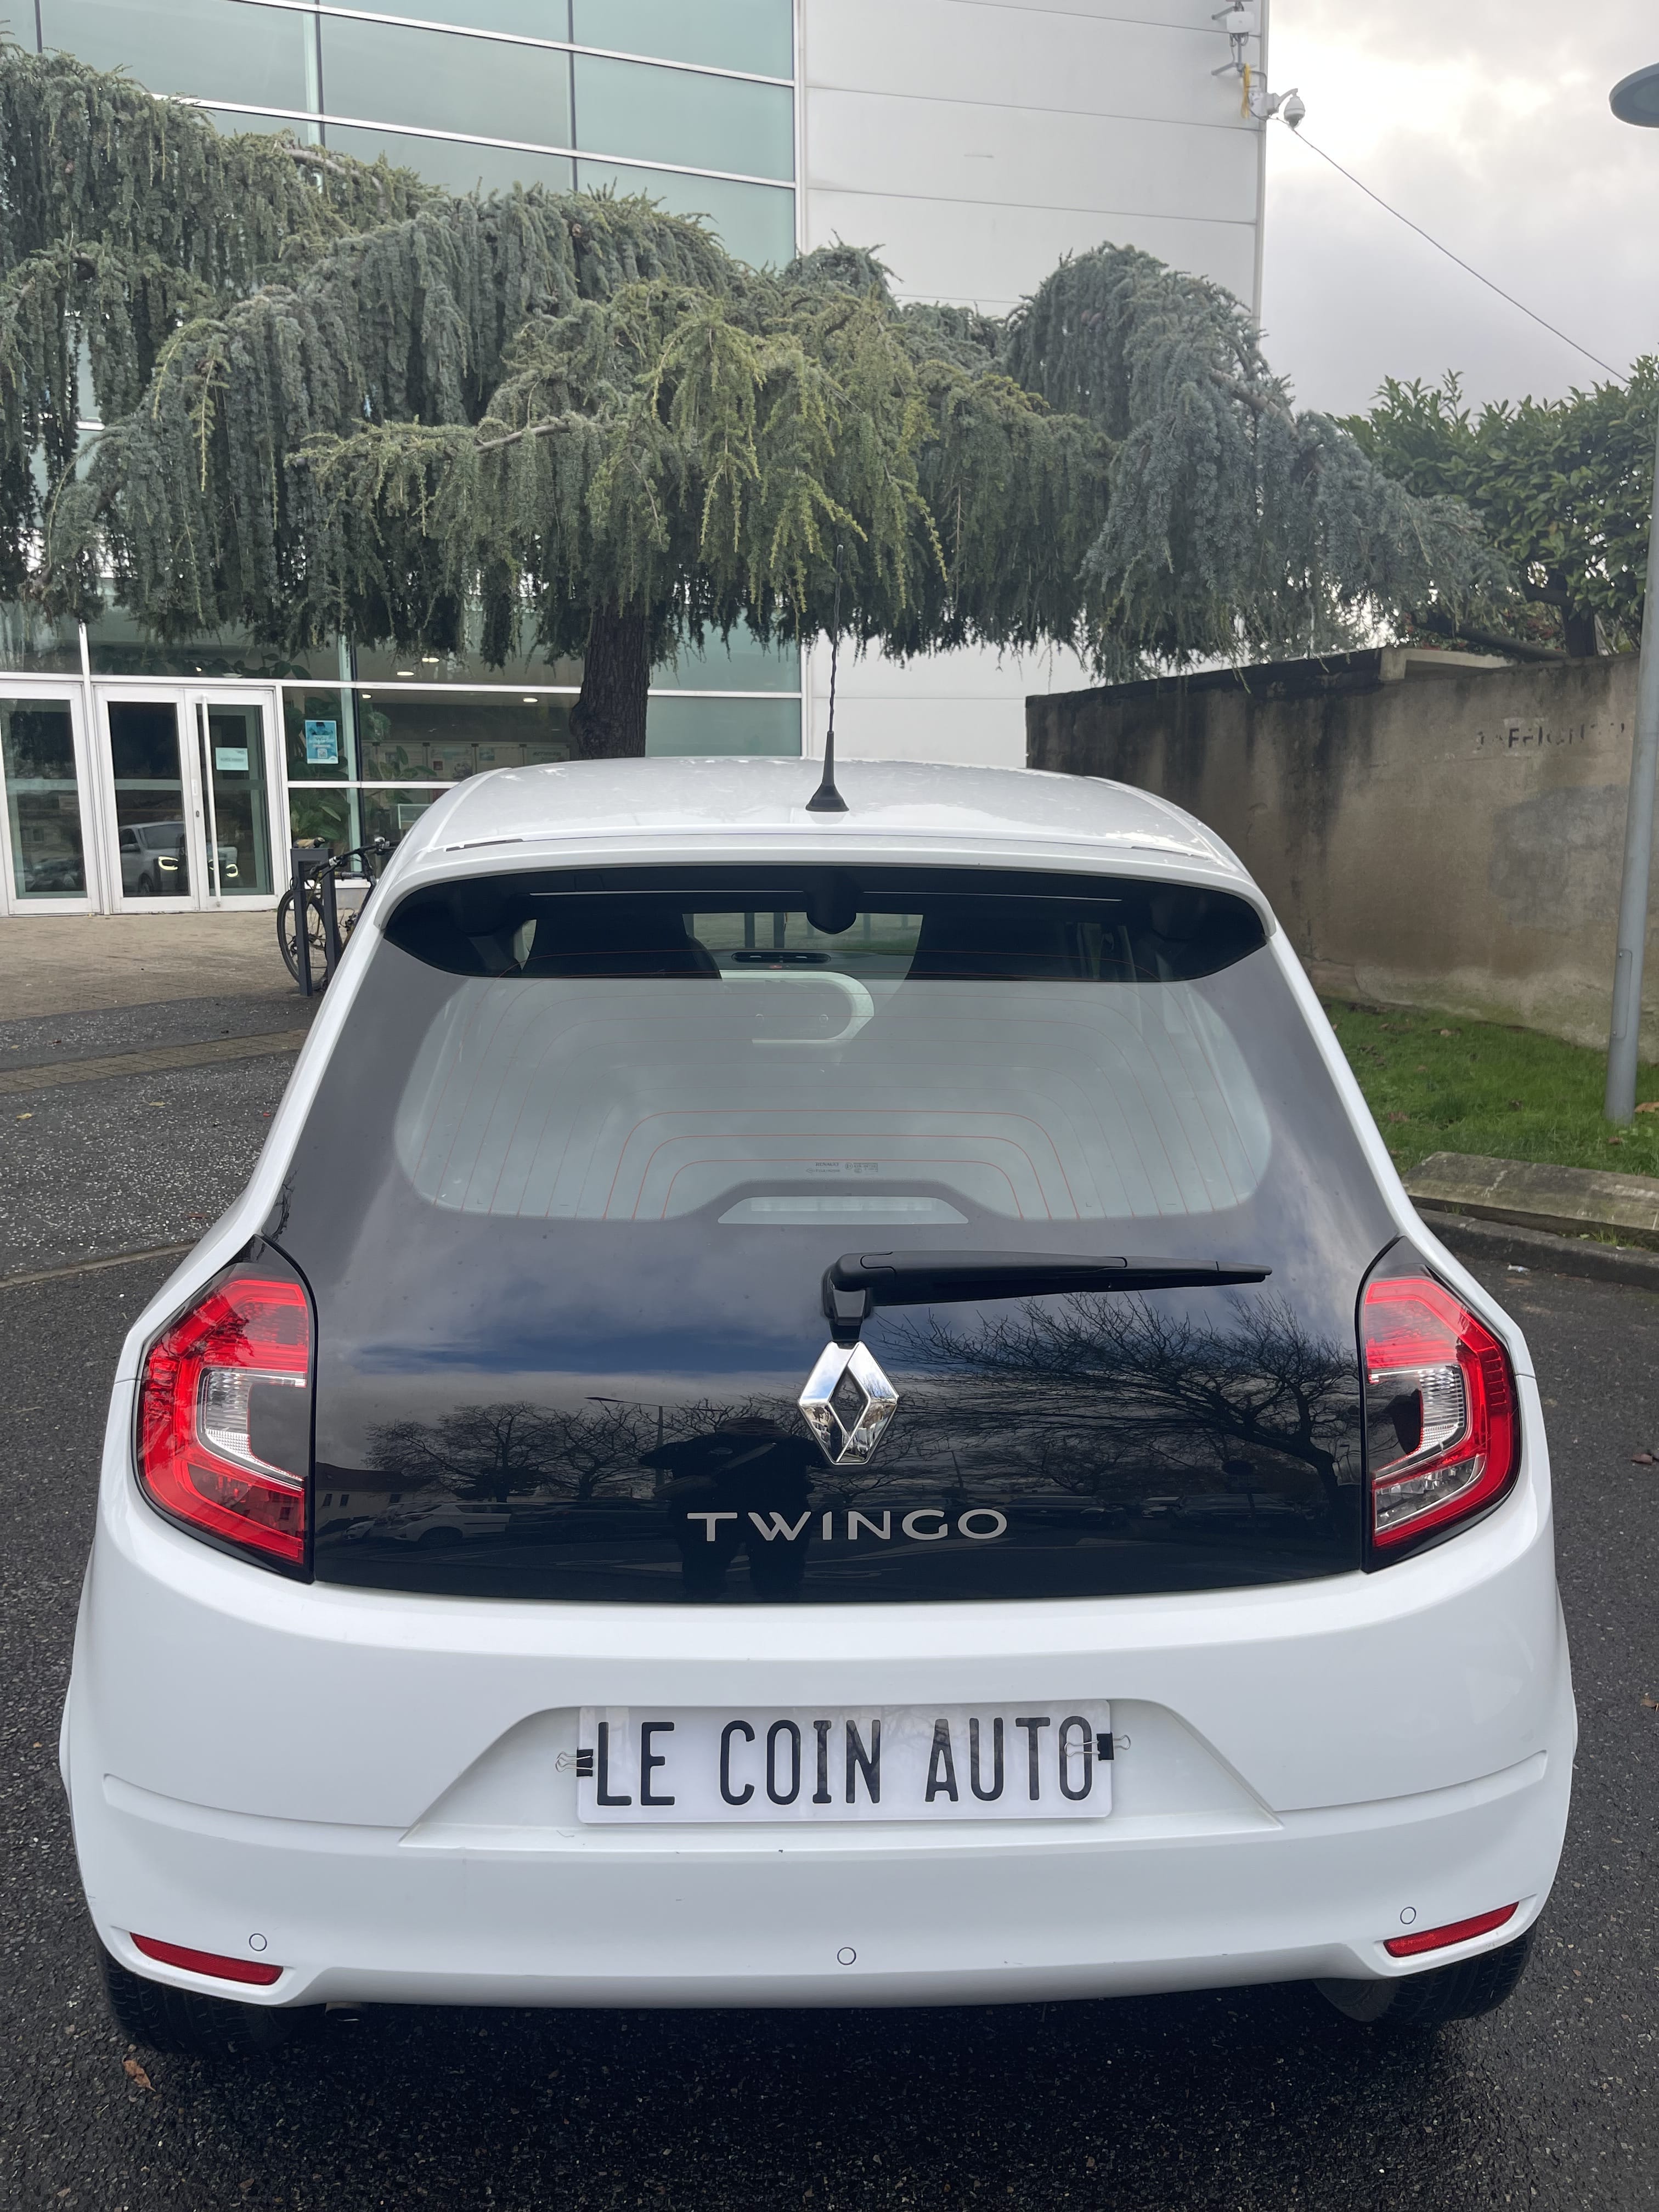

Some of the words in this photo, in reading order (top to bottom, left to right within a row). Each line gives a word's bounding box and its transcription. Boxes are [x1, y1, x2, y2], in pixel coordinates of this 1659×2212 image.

[687, 1508, 1008, 1542] TWINGO
[597, 1721, 675, 1806] LE
[720, 1719, 881, 1806] COIN
[924, 1716, 1092, 1802] AUTO
